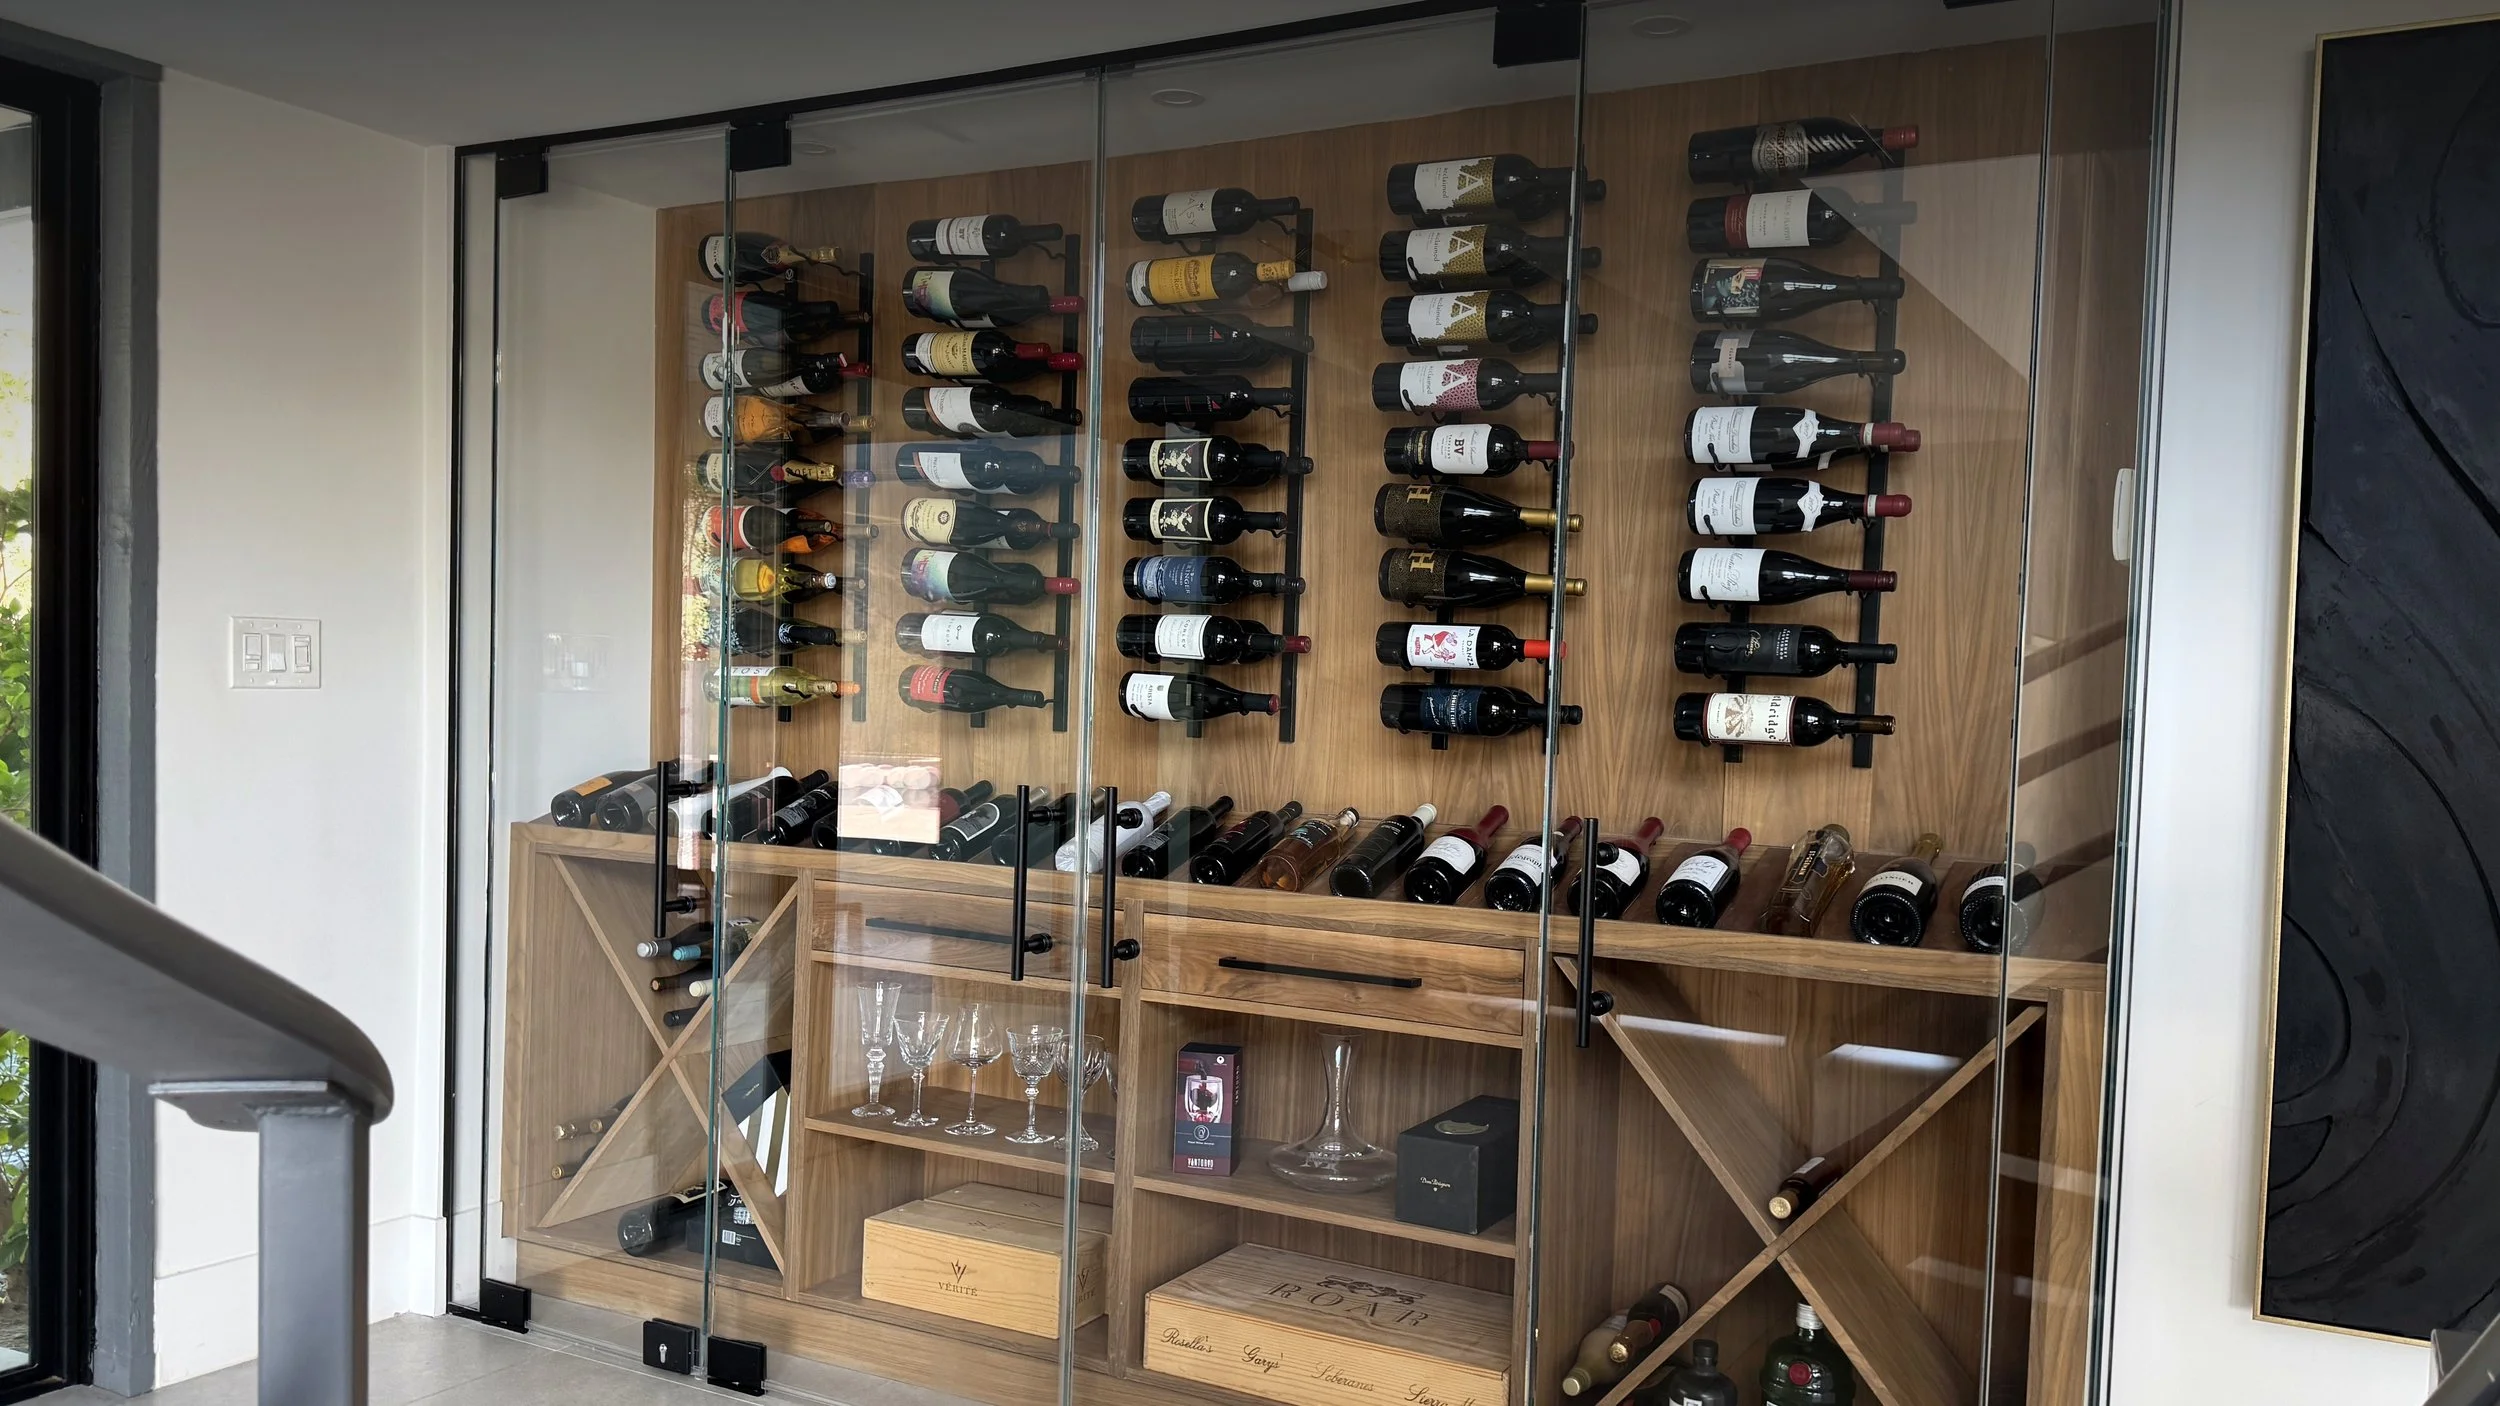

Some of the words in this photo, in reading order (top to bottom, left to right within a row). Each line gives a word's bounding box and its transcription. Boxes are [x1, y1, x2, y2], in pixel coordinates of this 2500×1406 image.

[1435, 297, 1443, 326] acclaimed
[1454, 438, 1465, 456] BV
[1467, 628, 1475, 638] LA
[1466, 640, 1474, 667] DANZA
[1263, 1281, 1429, 1328] ROAR
[1160, 1327, 1214, 1354] Rosella's
[1311, 1360, 1376, 1394] Soberanes
